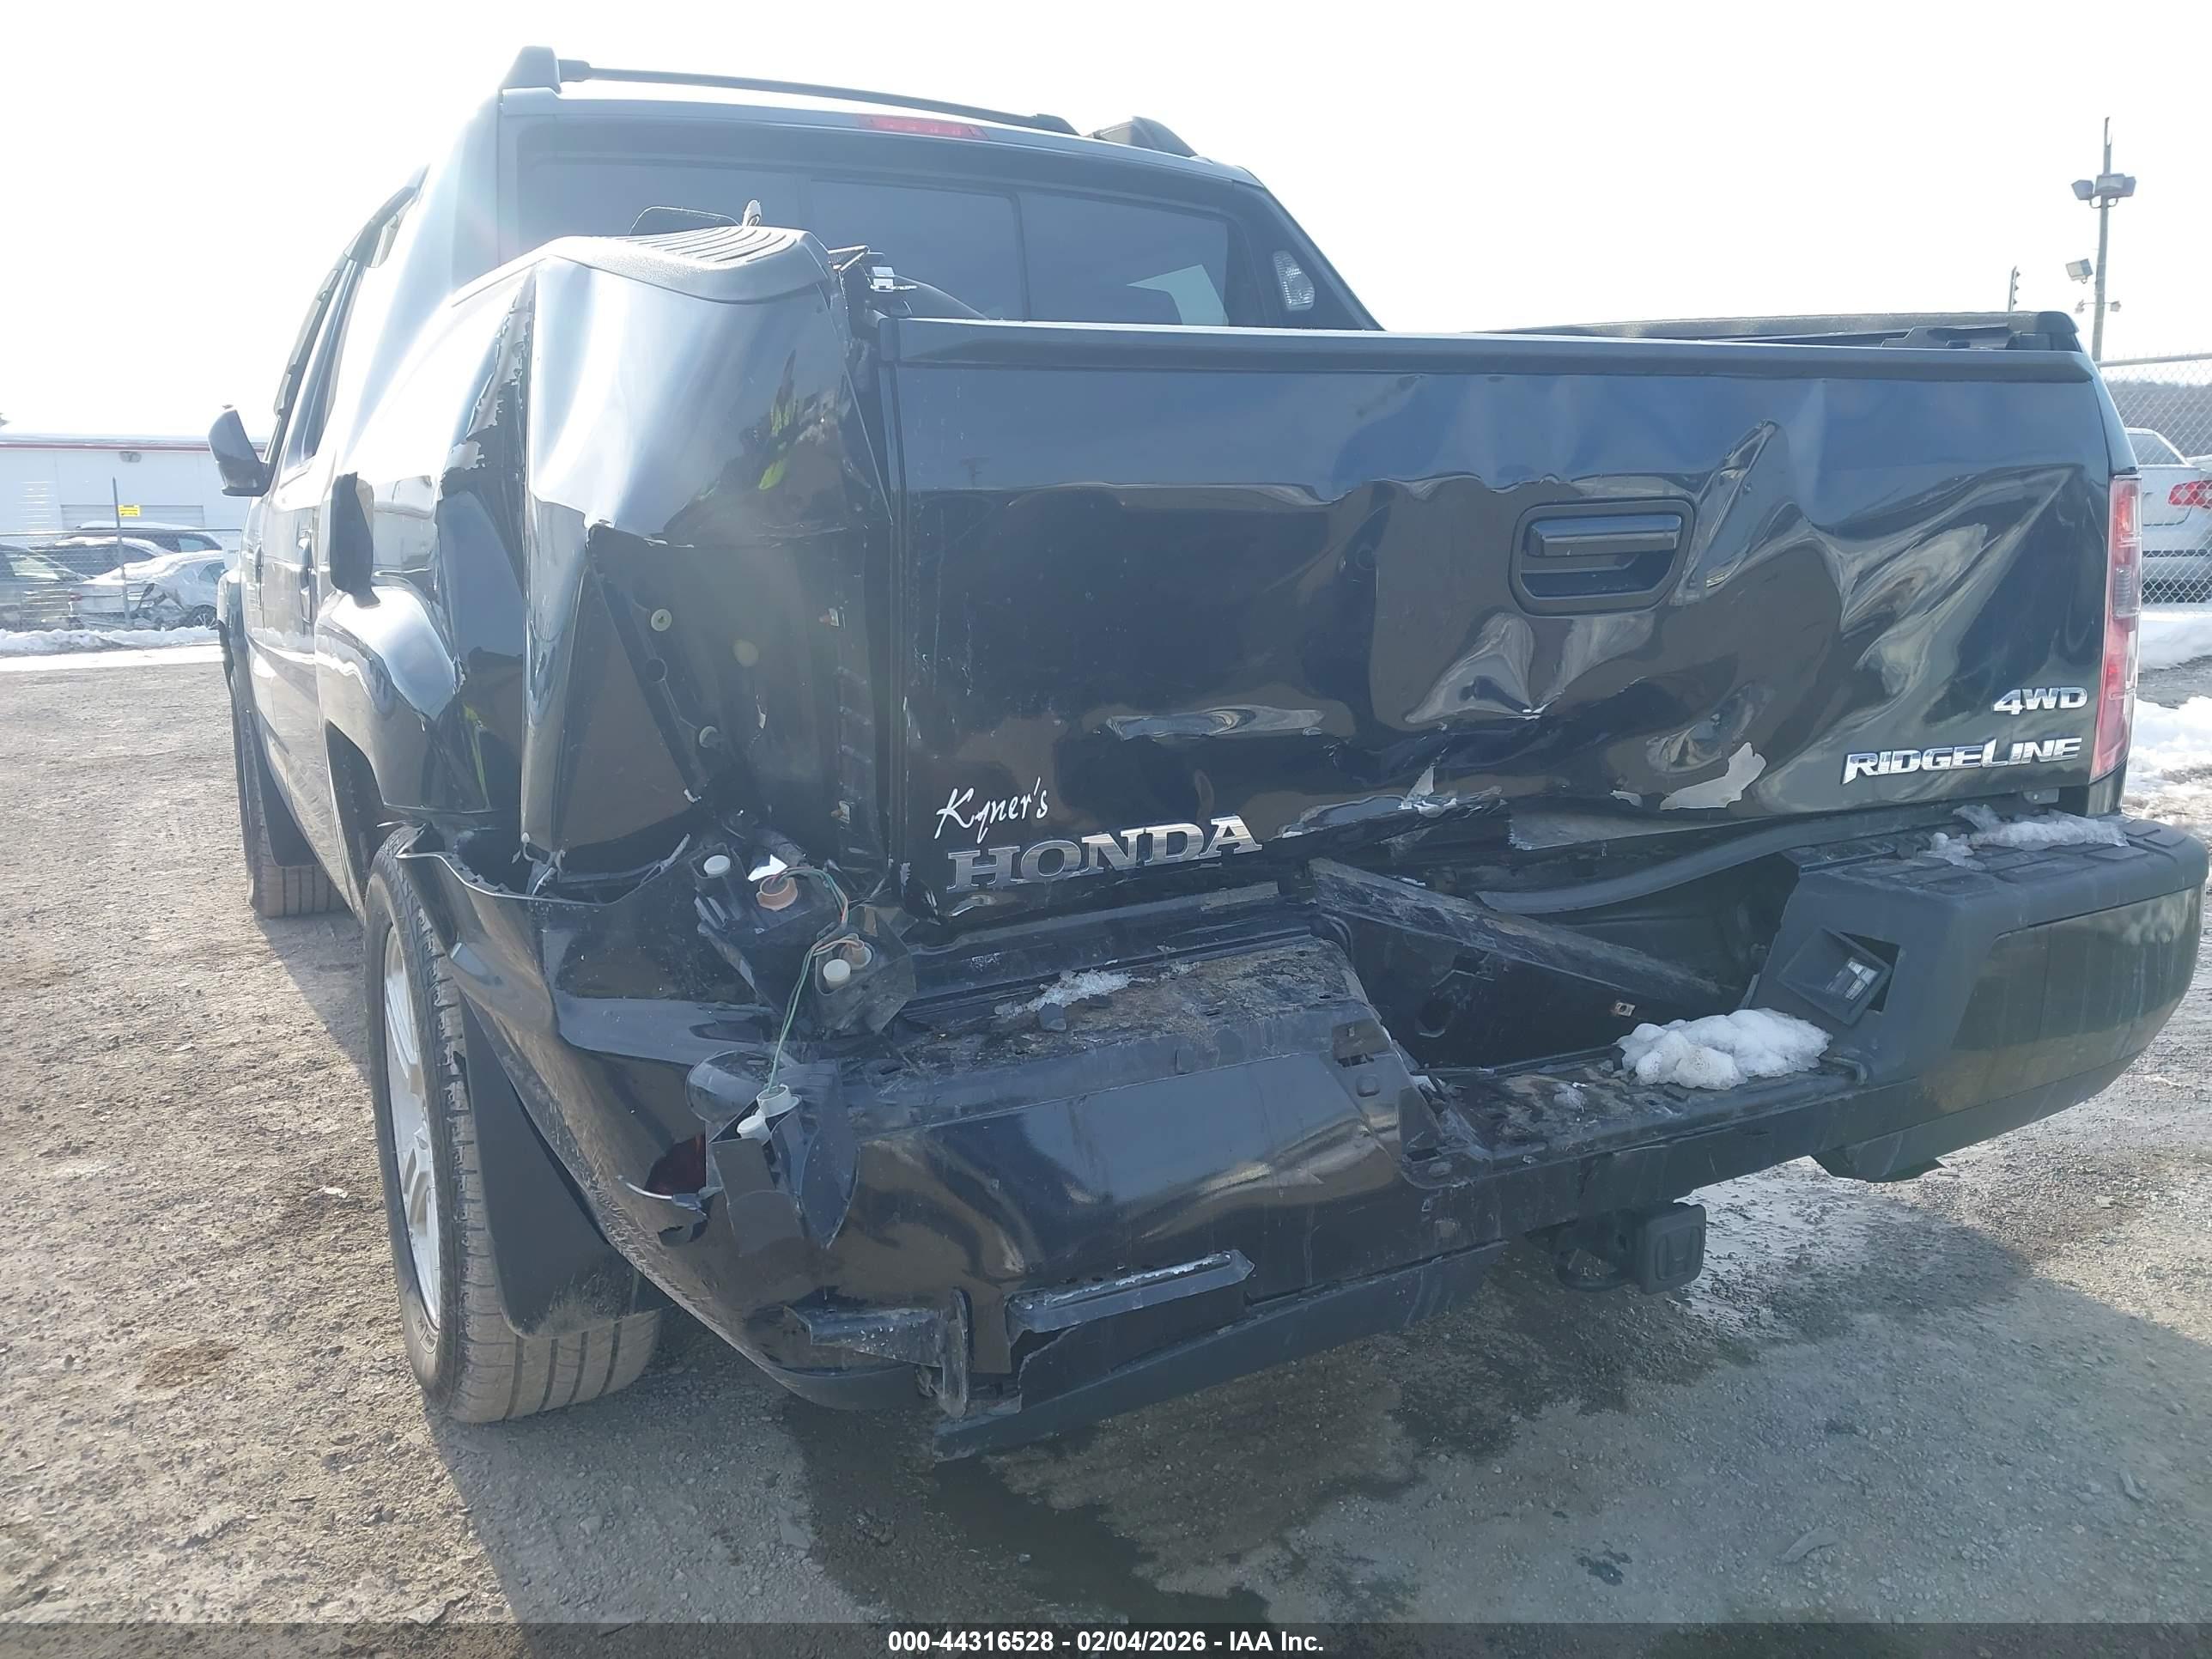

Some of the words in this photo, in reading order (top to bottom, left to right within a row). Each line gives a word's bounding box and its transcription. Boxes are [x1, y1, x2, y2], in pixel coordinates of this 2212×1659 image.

[1992, 687, 2087, 715] 4WD
[1842, 738, 2082, 785] RIDGELINE
[946, 815, 1263, 893] HONDA
